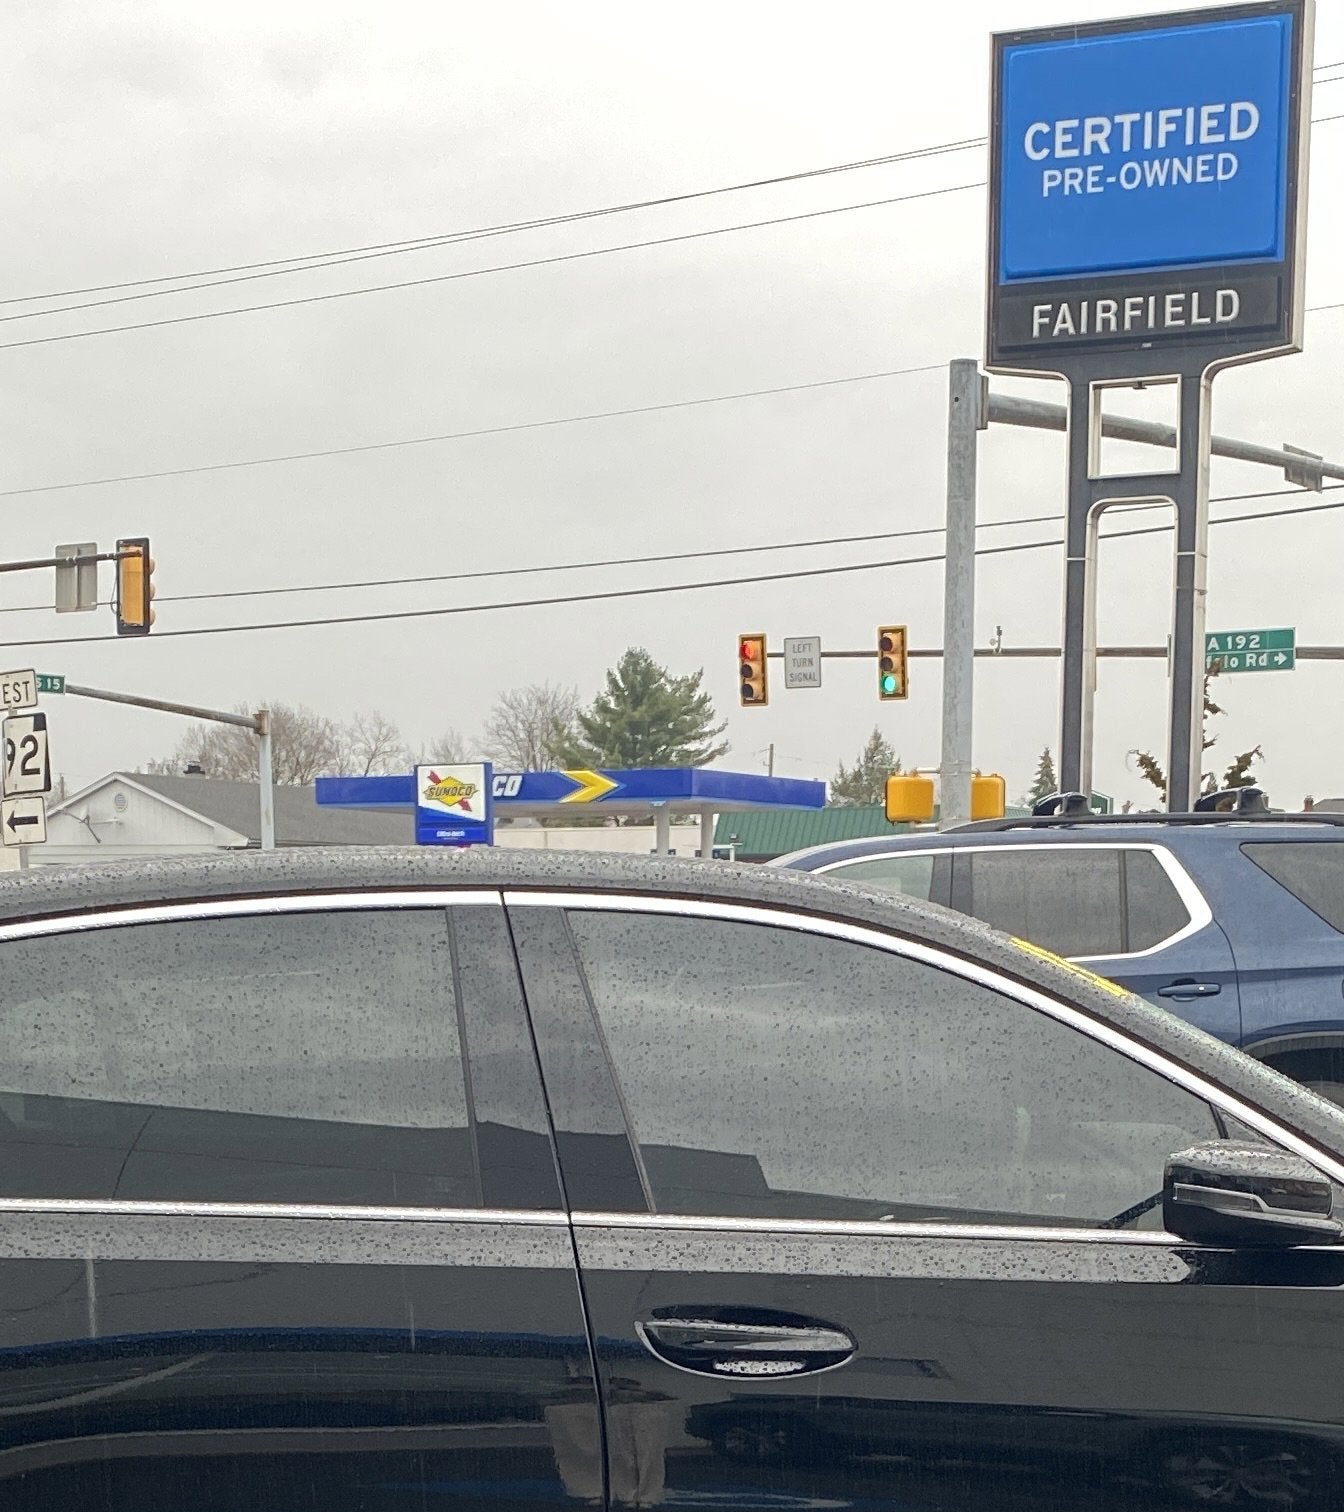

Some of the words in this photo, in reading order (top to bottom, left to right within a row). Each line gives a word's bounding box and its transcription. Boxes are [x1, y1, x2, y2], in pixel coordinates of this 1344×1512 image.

[1023, 101, 1260, 161] CERTIFIED
[1042, 152, 1239, 197] PRE-OWNED
[1032, 289, 1241, 339] FAIRFIELD
[792, 643, 813, 654] LEFT
[1226, 634, 1261, 650] 192
[792, 657, 814, 668] TURN
[1246, 652, 1268, 668] Rd
[46, 677, 61, 690] 15
[789, 672, 817, 683] SIGNAL
[428, 786, 473, 798] SUNOCO
